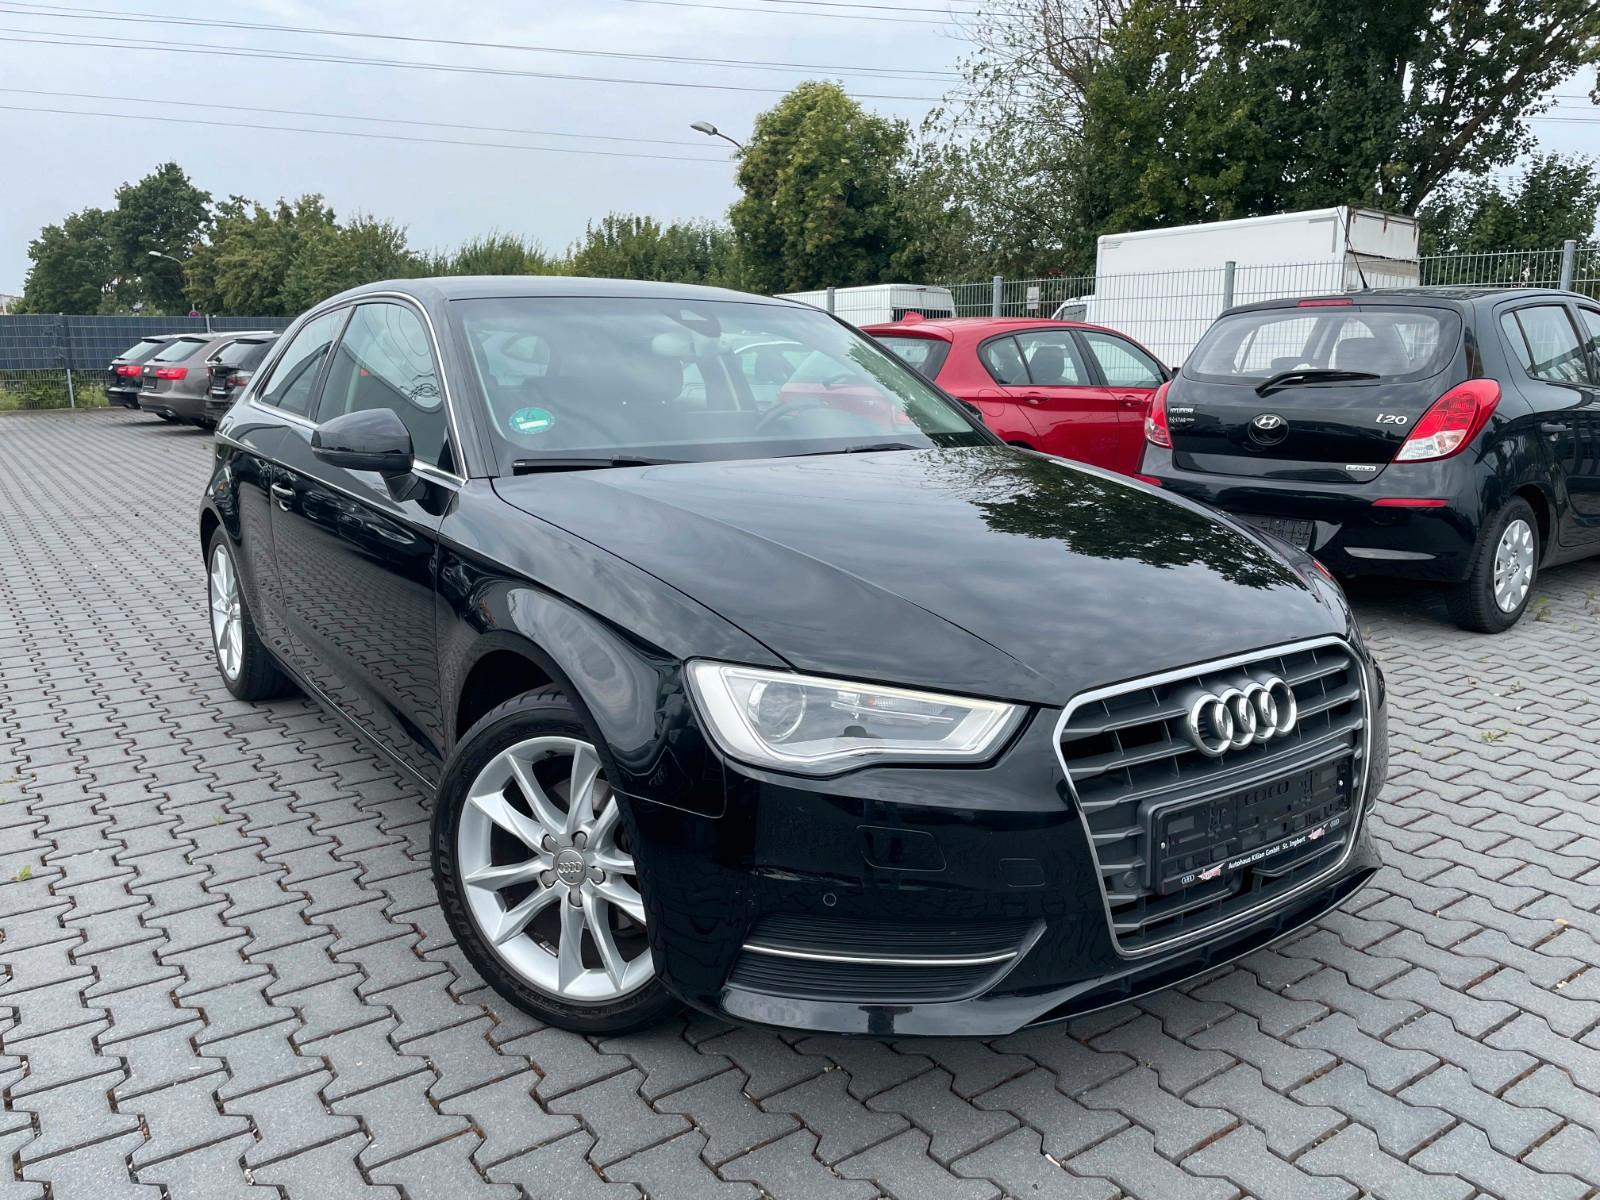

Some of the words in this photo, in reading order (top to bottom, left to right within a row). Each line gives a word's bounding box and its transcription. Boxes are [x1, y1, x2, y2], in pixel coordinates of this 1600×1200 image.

[1375, 413, 1408, 425] i20
[1228, 857, 1251, 870] Autohaus
[1265, 845, 1280, 856] GmbH
[1289, 835, 1306, 847] Ingbert
[438, 832, 487, 955] DUNLOP
